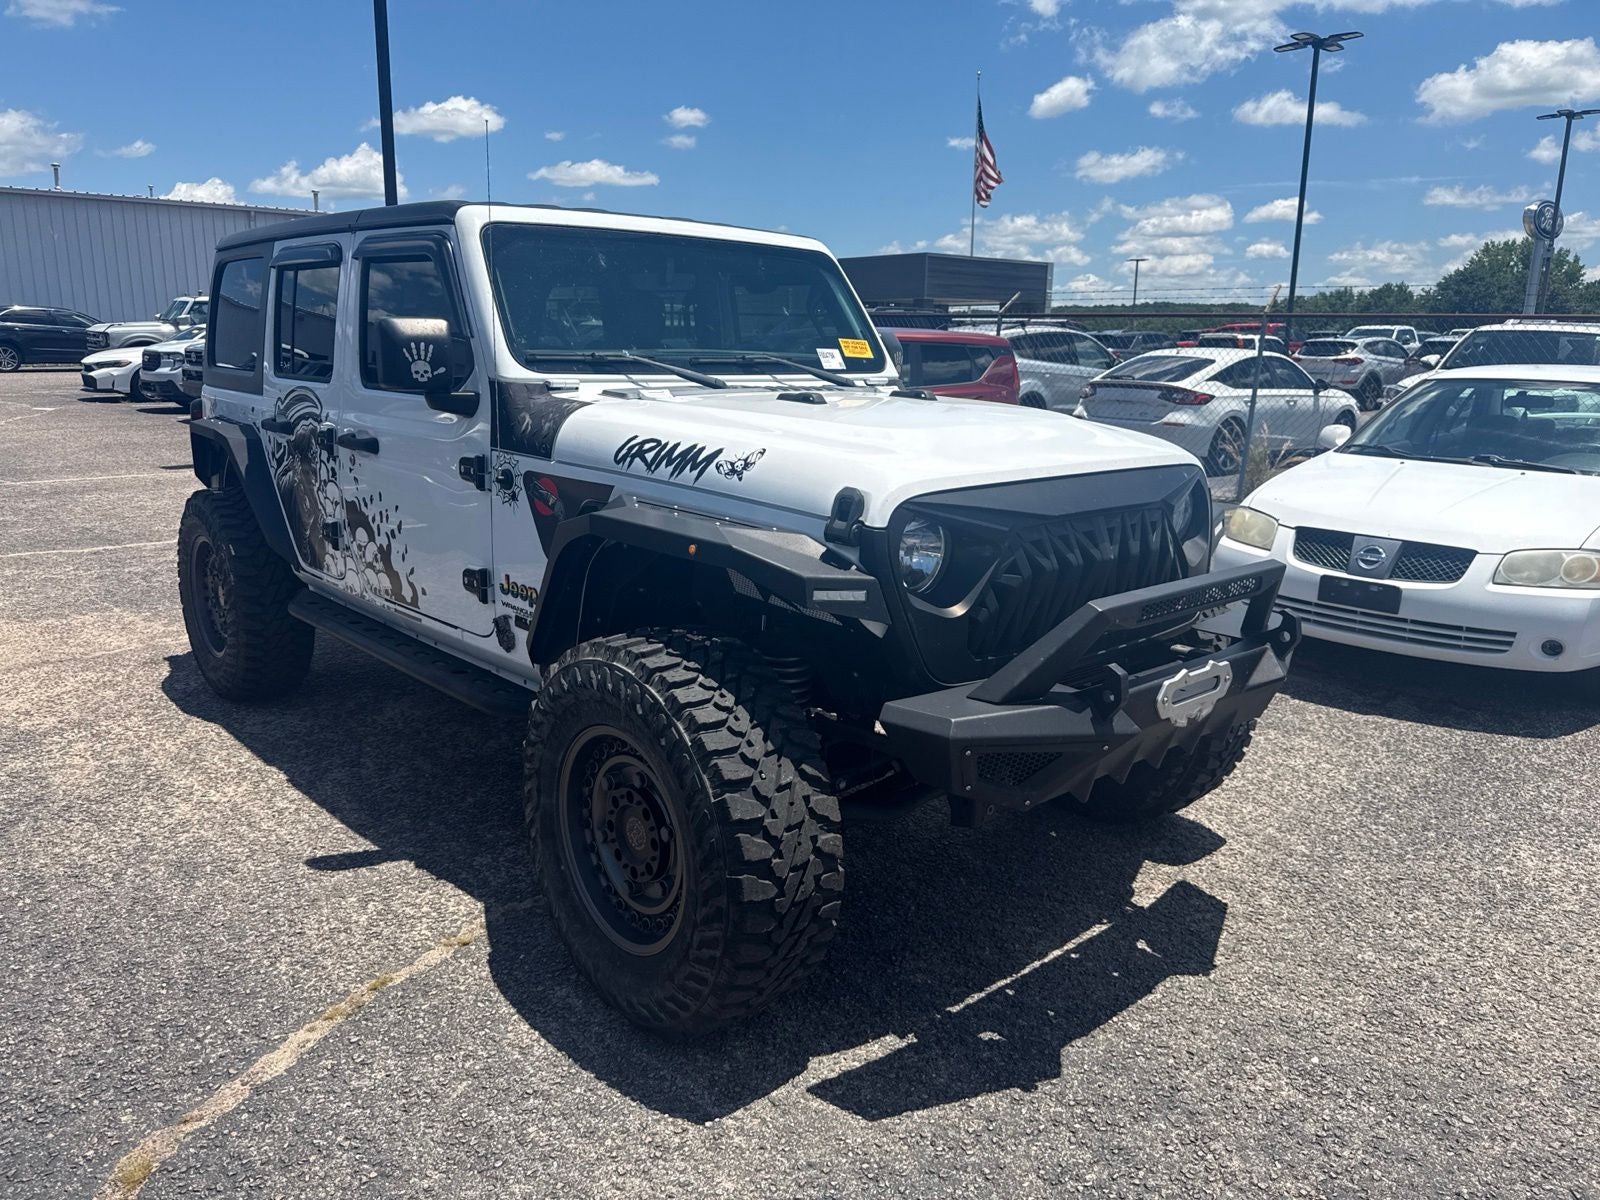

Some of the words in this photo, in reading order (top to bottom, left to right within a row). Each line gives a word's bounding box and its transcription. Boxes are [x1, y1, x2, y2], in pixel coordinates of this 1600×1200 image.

[613, 434, 725, 487] GRIMM
[499, 573, 539, 608] Jeep
[500, 599, 535, 616] WRANGLE
